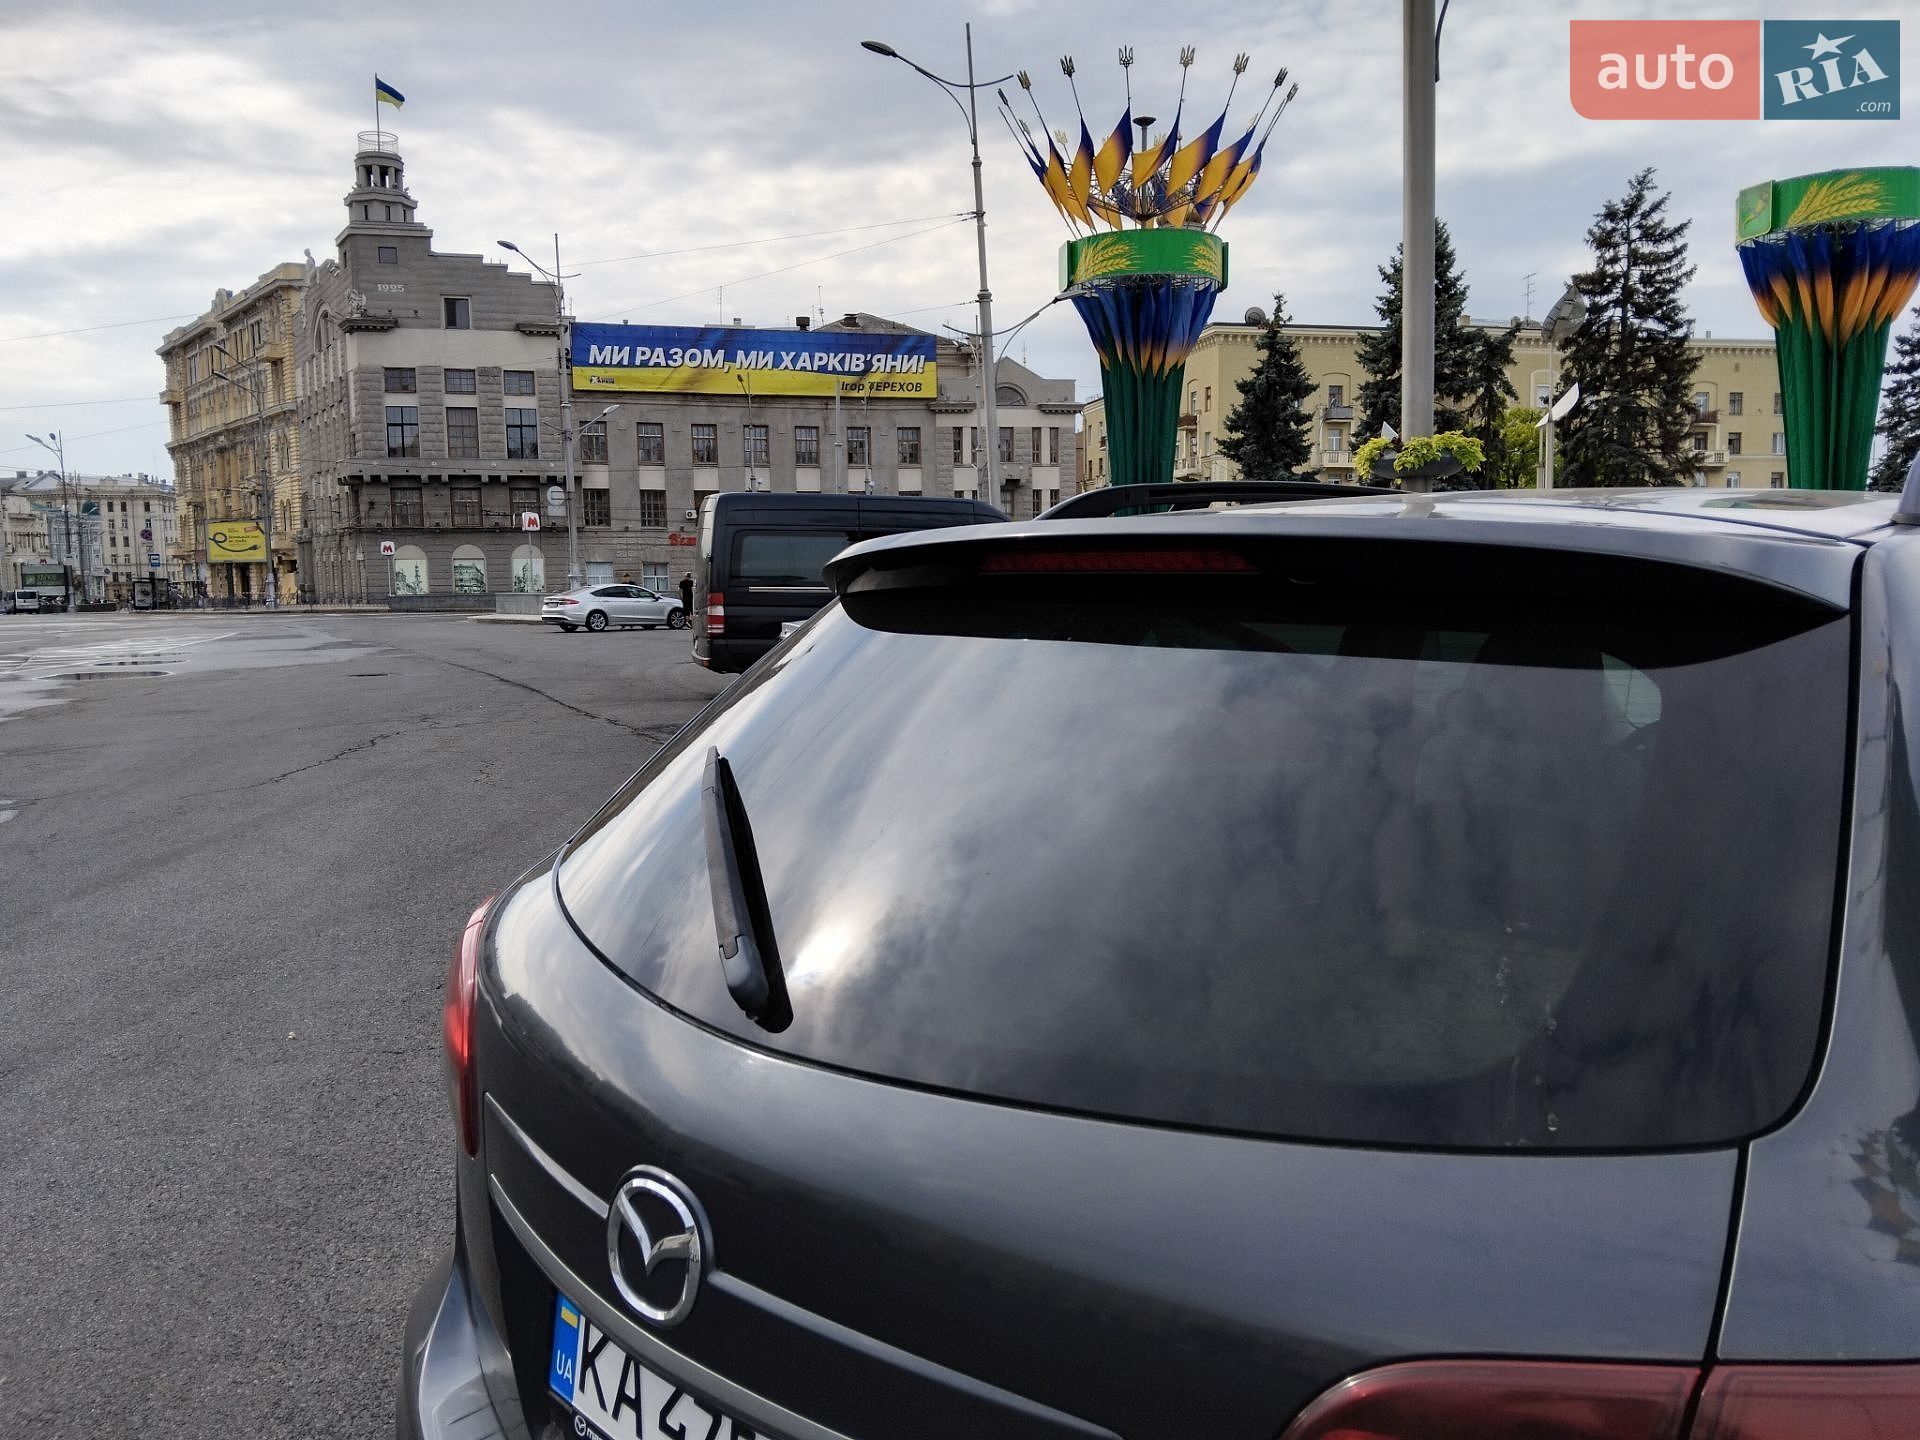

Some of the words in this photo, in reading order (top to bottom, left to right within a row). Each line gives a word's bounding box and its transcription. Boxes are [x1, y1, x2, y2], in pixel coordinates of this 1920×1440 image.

[589, 344, 631, 366] МИ
[635, 346, 731, 373] РАЗОМ,
[736, 350, 774, 370] МИ
[841, 381, 865, 393] Ігор
[556, 1349, 573, 1385] UA
